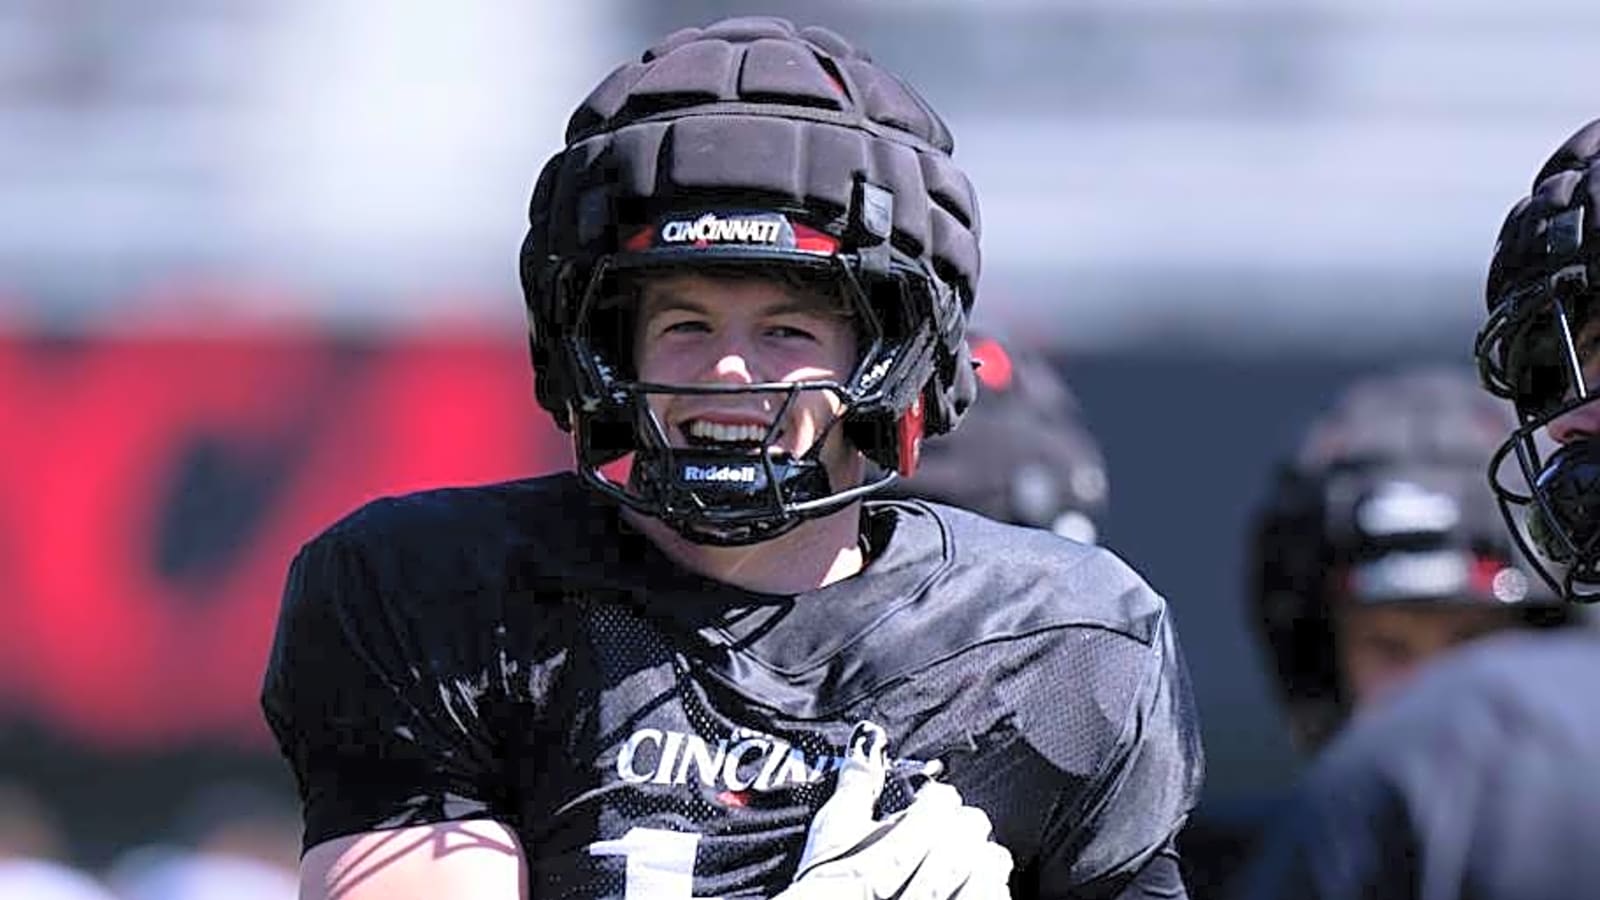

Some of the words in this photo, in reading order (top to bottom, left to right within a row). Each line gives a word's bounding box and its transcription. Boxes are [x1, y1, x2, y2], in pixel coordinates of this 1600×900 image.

[662, 217, 780, 242] CINCINNATI
[685, 465, 755, 482] Riddell
[617, 728, 847, 791] CINCIN
